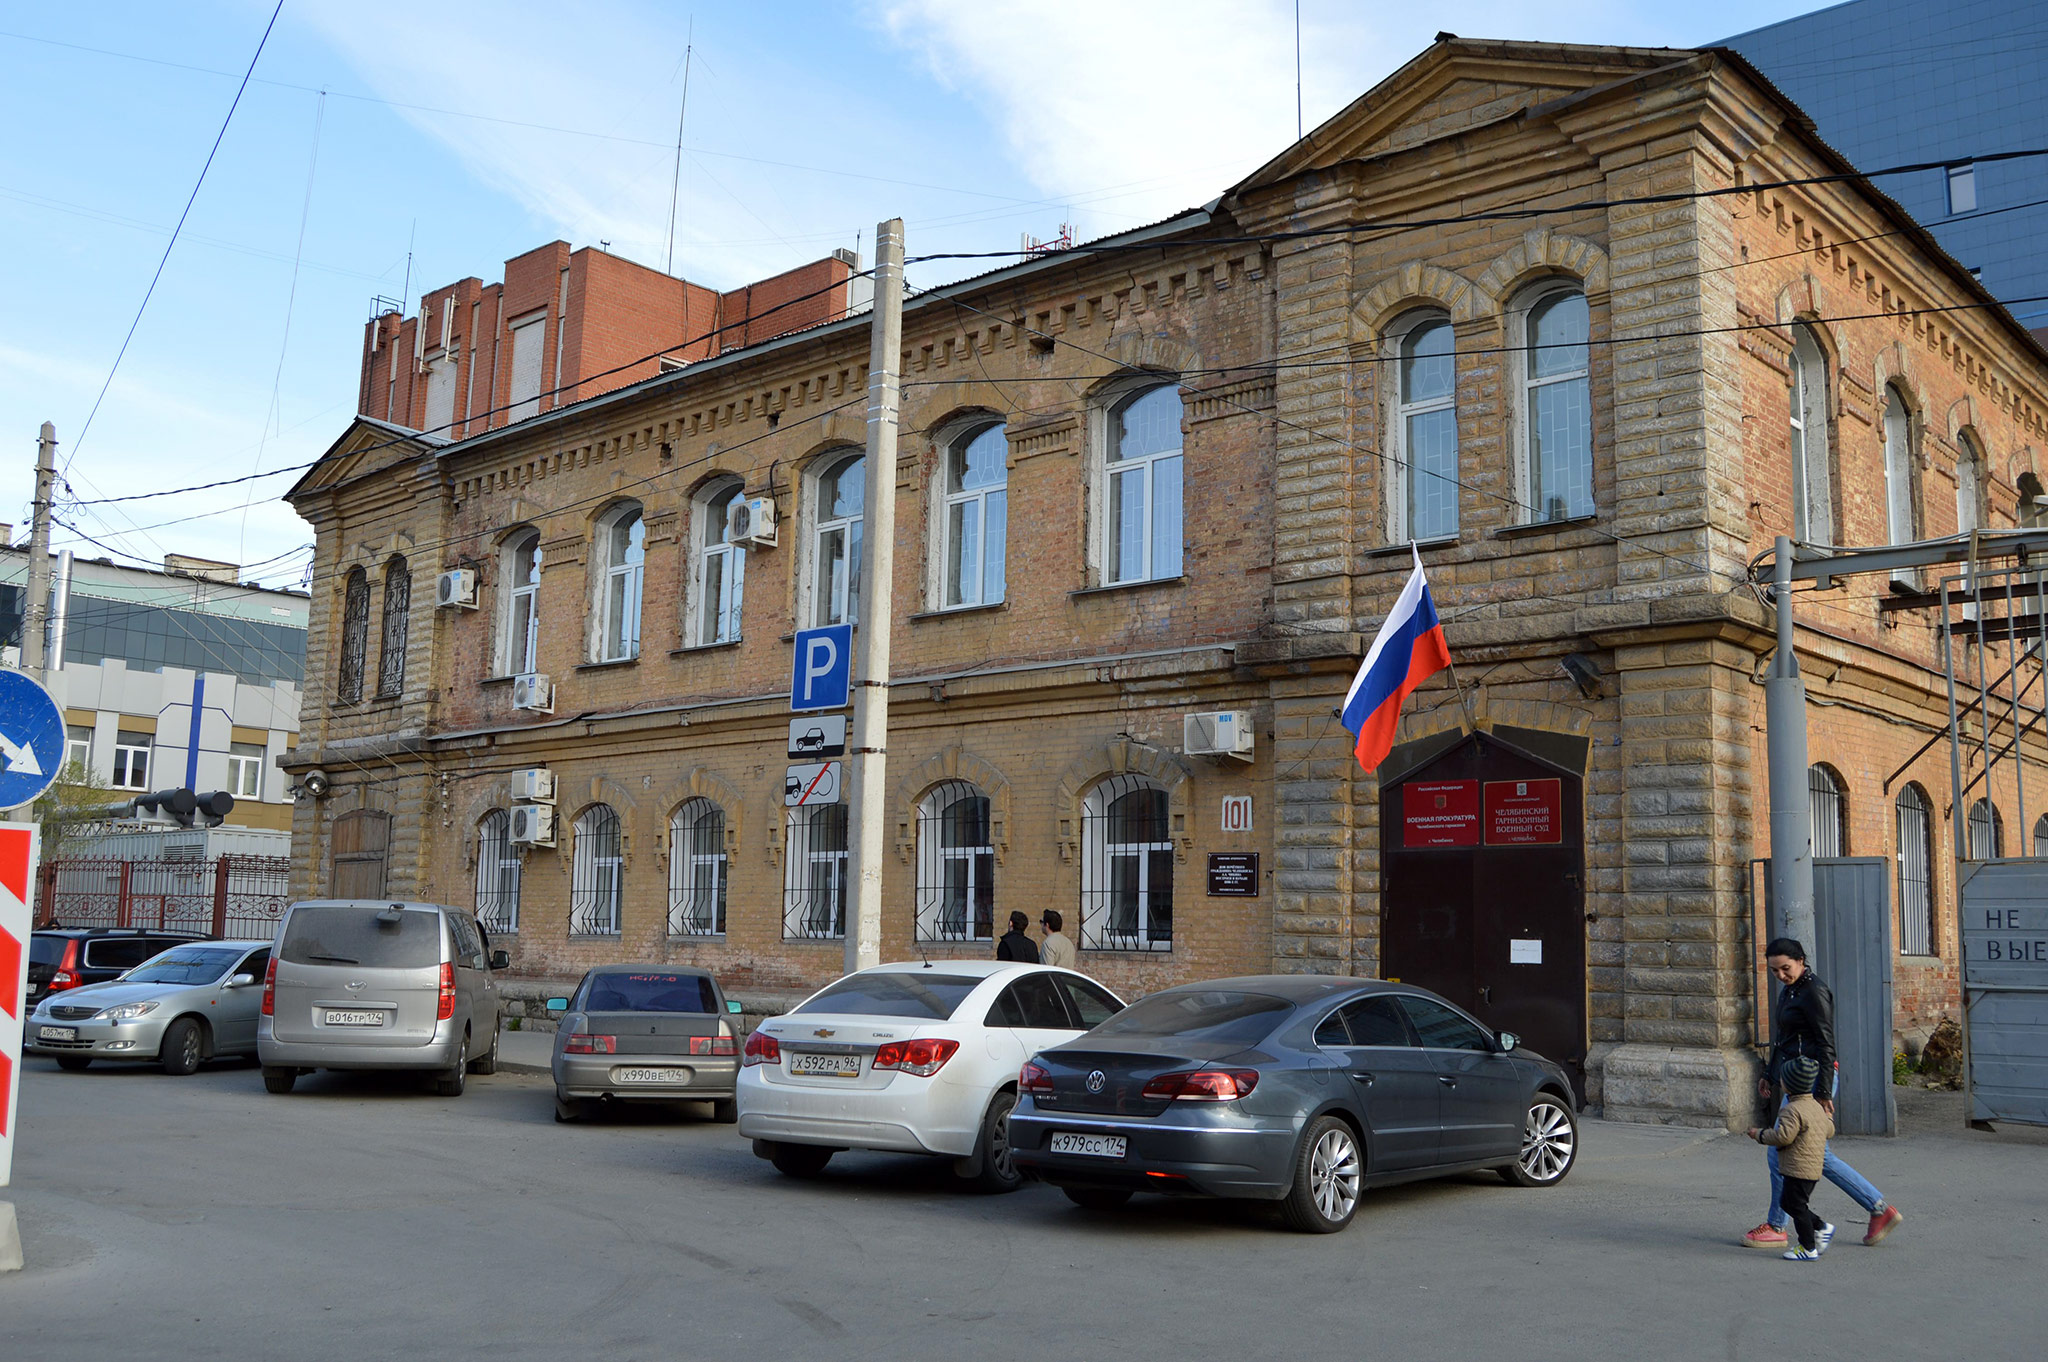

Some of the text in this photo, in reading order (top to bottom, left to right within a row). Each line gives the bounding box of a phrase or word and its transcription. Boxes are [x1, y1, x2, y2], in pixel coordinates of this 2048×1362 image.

[804, 636, 837, 700] P
[1219, 714, 1232, 722] MDV
[1225, 800, 1248, 829] 101
[1495, 807, 1549, 816] ЧЕЛЯБИНСКИЙ
[1435, 814, 1476, 822] ПРОКУРАТУРА
[1495, 815, 1549, 824] ГАРНИЗОННЫЙ
[1496, 824, 1549, 833] ВОЕННЫЙ СУД
[1986, 910, 2019, 928] НЕ
[328, 1013, 364, 1022] В016ТР
[796, 1056, 855, 1070] Х592РА 96
[624, 1070, 682, 1080] Х990ВЕ 174
[1055, 1135, 1122, 1152] К979СС 174
